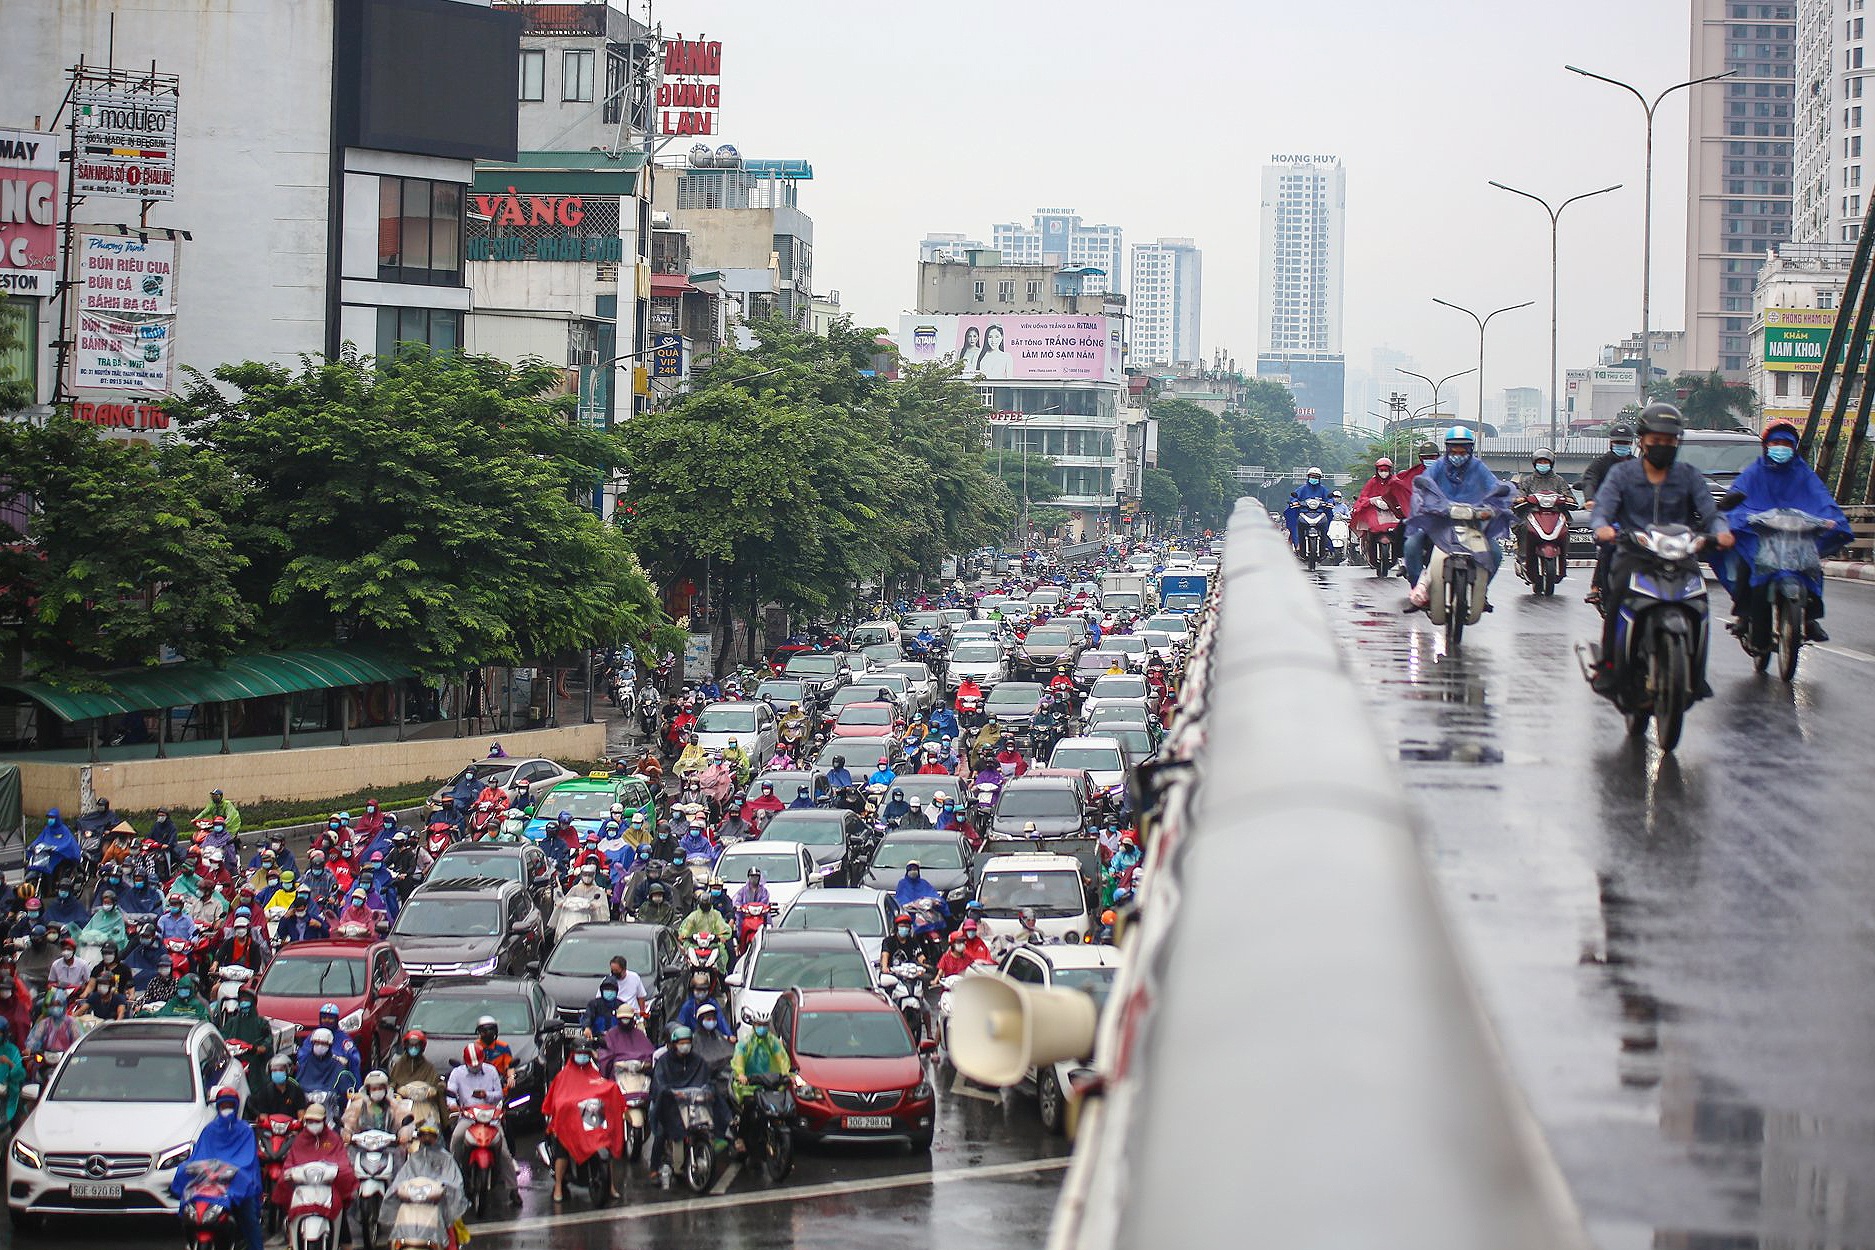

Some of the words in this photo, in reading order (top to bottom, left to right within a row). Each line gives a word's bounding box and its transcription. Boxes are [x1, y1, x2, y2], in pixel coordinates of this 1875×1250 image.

[101, 104, 166, 132] moduleo
[663, 111, 711, 135] LAN
[105, 134, 125, 146] MADE
[128, 136, 135, 147] IN
[136, 137, 167, 148] BELGIUM
[0, 139, 39, 161] MAY
[1313, 155, 1336, 163] HUY
[475, 185, 585, 228] VÀNG
[88, 255, 114, 270] BÚN
[117, 257, 144, 273] RIÊU
[147, 261, 170, 275] CUA
[88, 274, 113, 290] BÚN
[116, 276, 132, 291] CÁ
[87, 293, 120, 309] BÁNH
[142, 297, 158, 312] CÁ
[82, 335, 108, 351] BÁNH
[1045, 334, 1077, 346] TRẮNG
[1783, 330, 1809, 340] KHÁM
[1022, 350, 1039, 359] LÀM
[1056, 351, 1074, 361] SẠM
[1769, 341, 1793, 357] NAM
[1795, 342, 1822, 358] KHOA
[658, 366, 677, 374] 24K
[660, 358, 677, 366] VIP
[73, 402, 136, 428] TRANG
